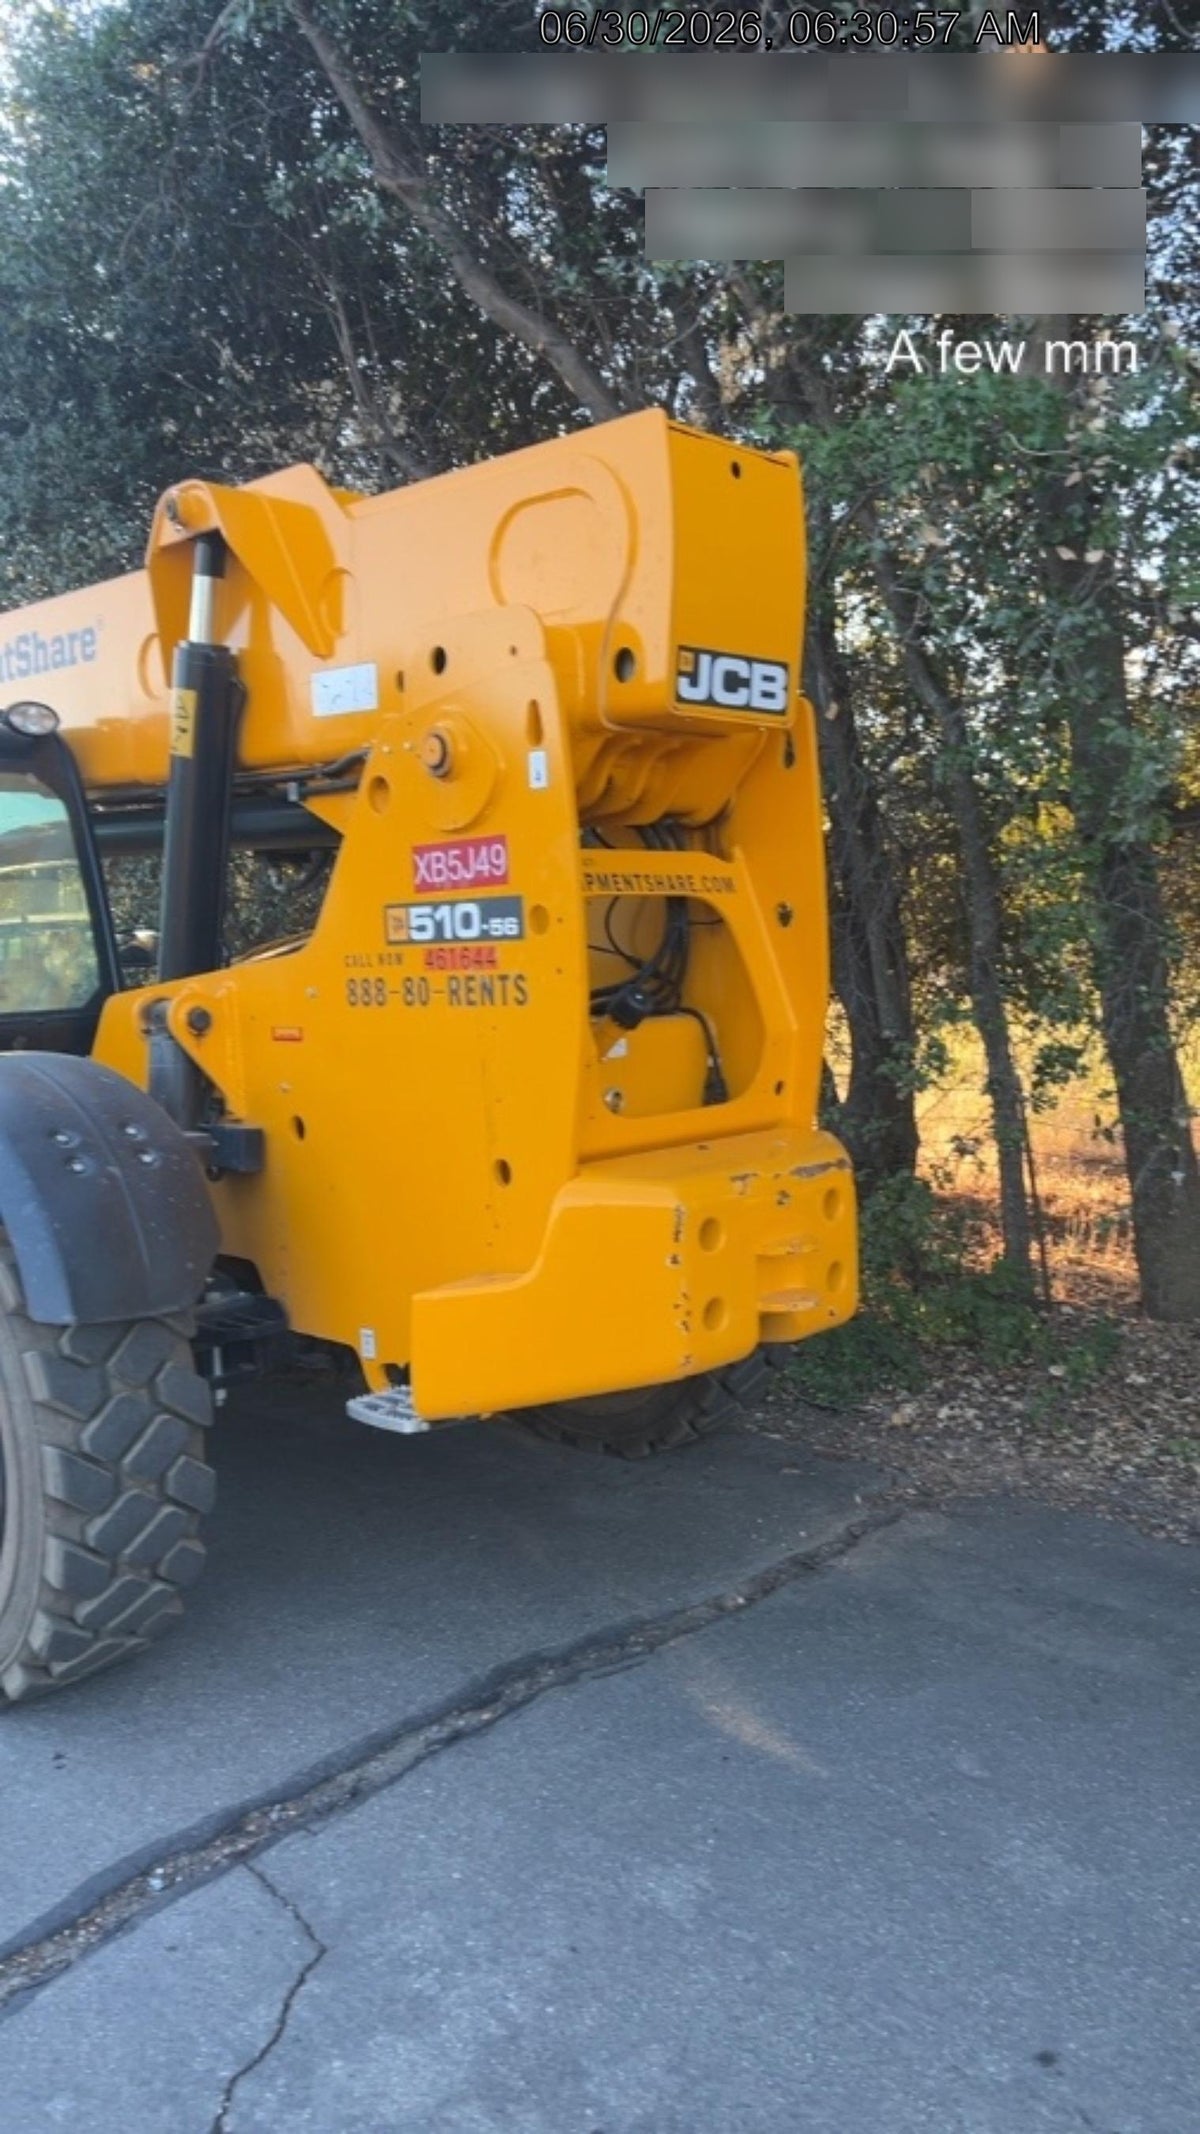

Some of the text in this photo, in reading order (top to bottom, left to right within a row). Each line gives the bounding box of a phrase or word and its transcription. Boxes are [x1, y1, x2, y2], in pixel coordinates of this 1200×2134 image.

[677, 653, 788, 712] JCB
[413, 843, 506, 885] XB5J49
[409, 903, 520, 940] 510-56
[344, 954, 373, 968] CALL
[425, 946, 497, 970] 461644
[346, 973, 529, 1007] 888-80-RENTS
